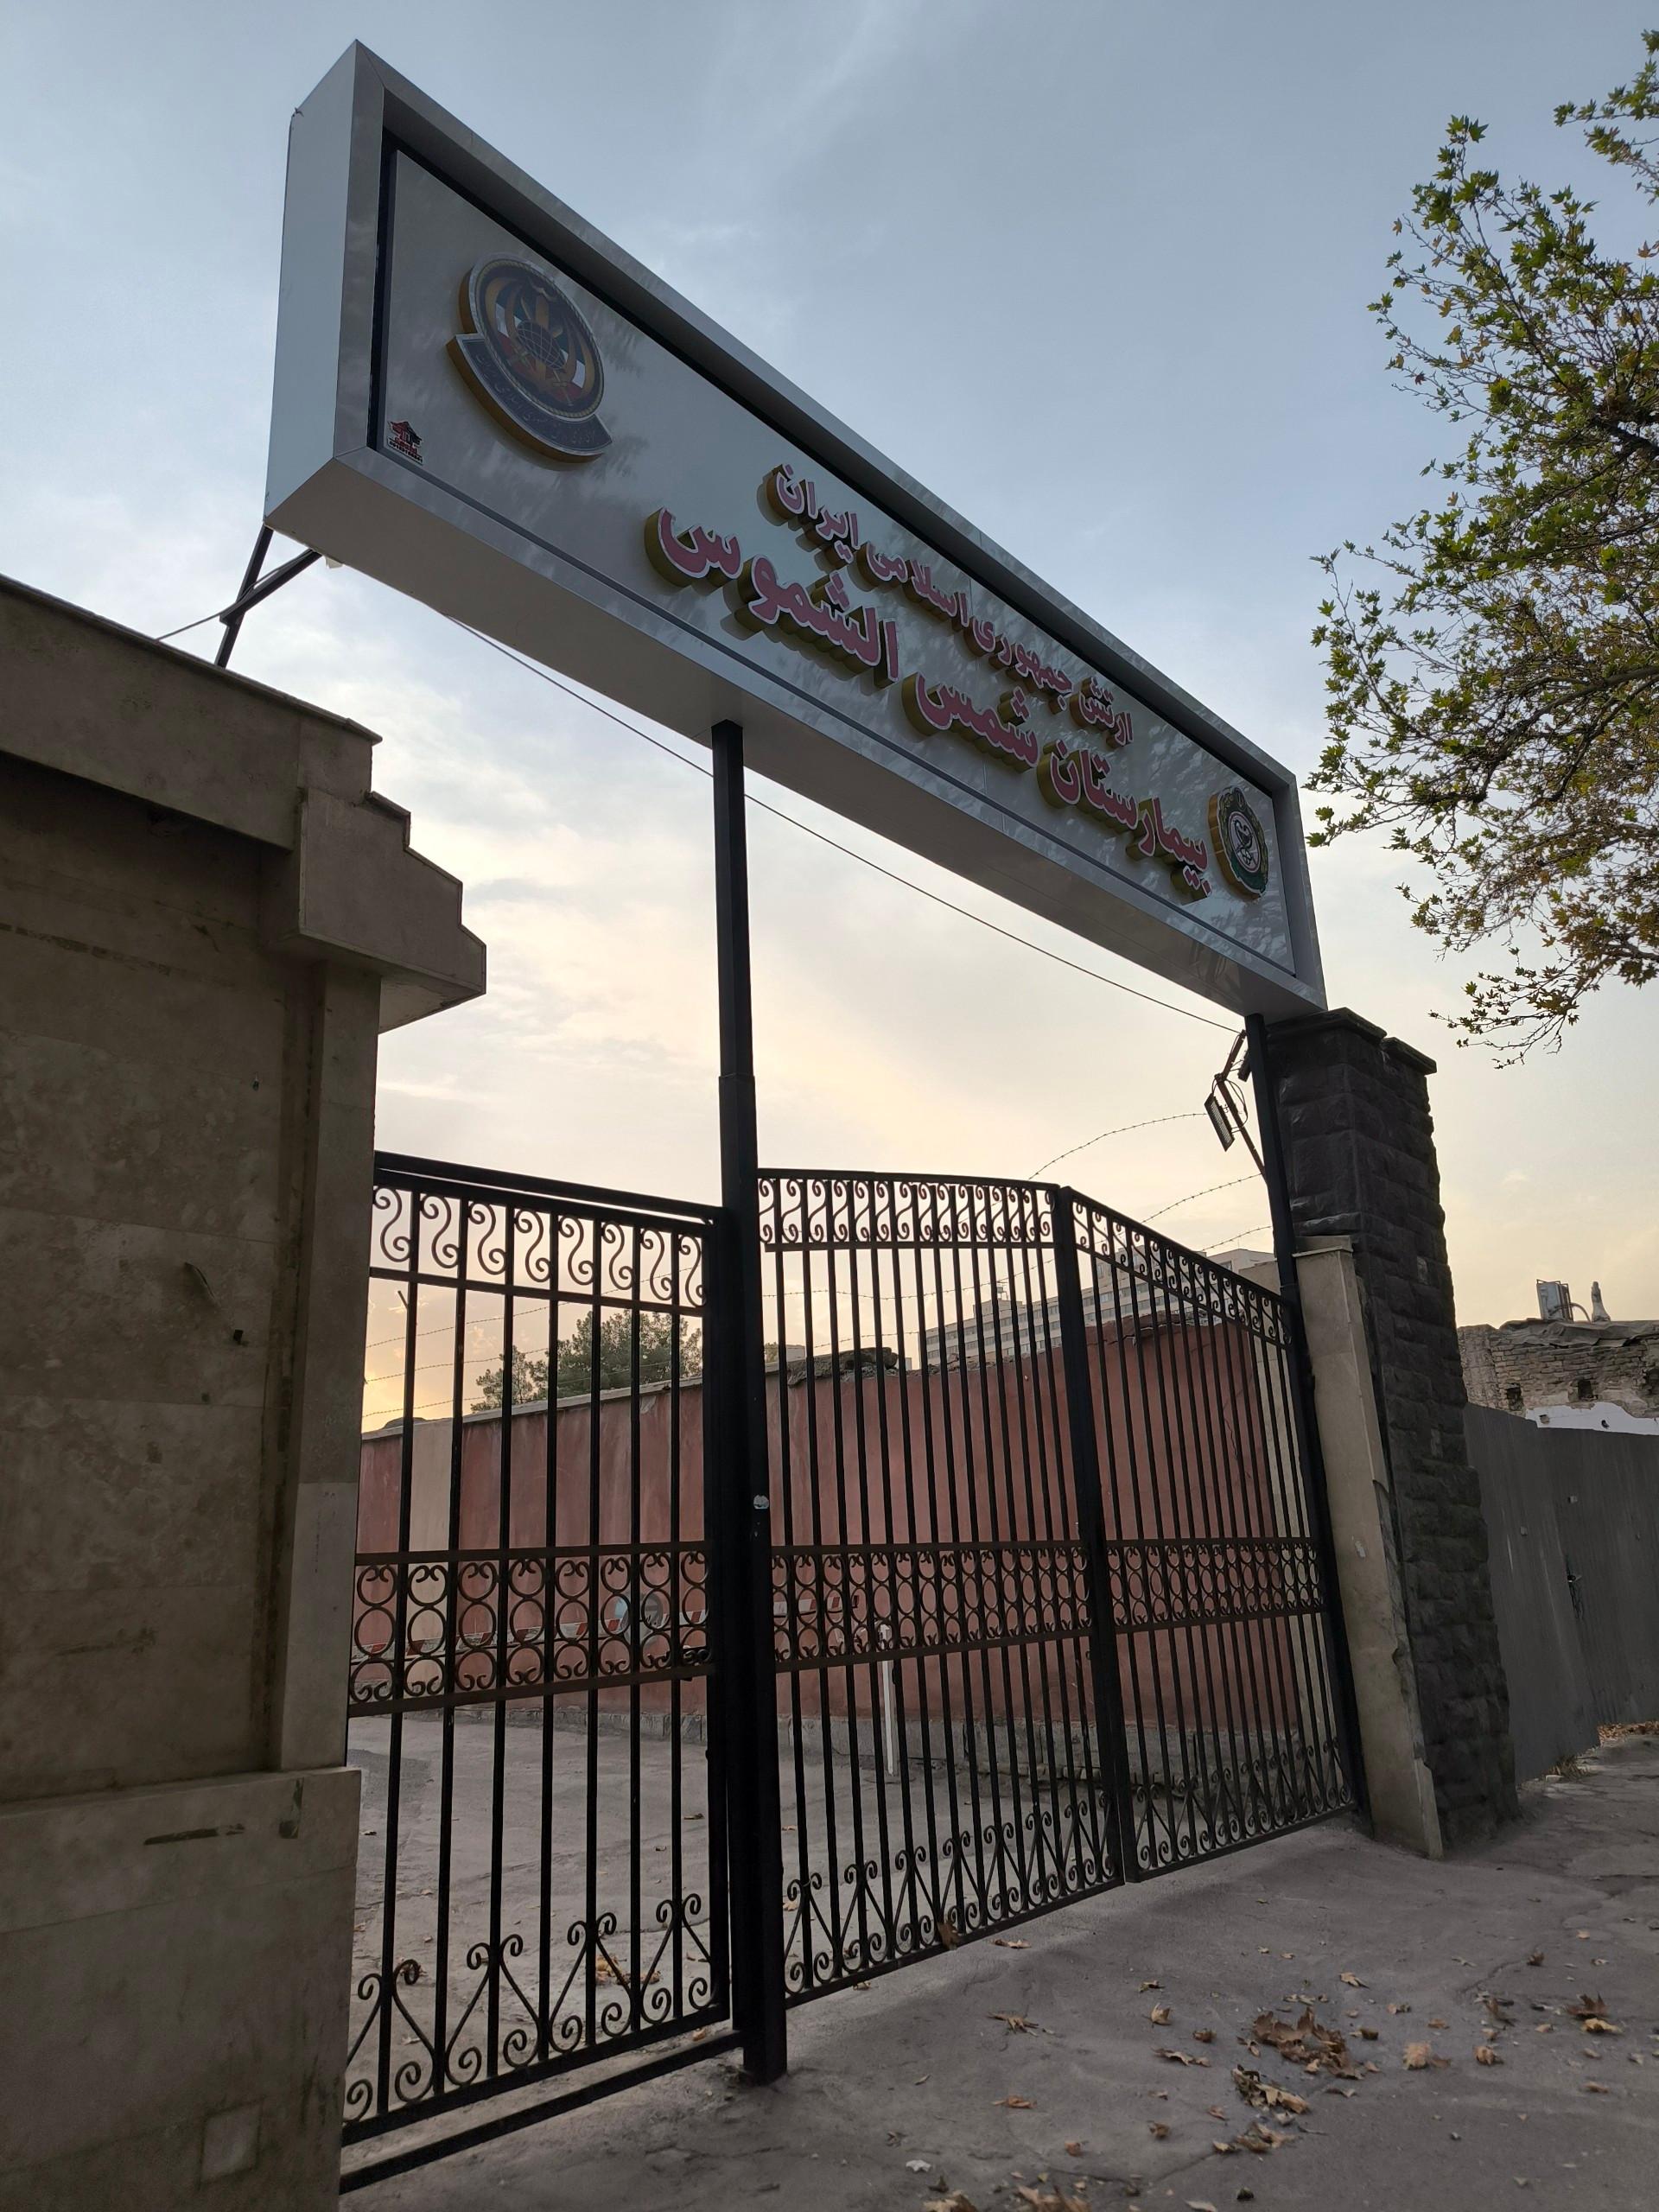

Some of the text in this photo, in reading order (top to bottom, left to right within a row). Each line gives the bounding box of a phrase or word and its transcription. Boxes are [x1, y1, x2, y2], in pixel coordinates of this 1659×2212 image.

[658, 506, 1211, 898] بیمارستان شمس الشموس
[776, 463, 1134, 747] ارتش جمهوری اسلامی ایران
